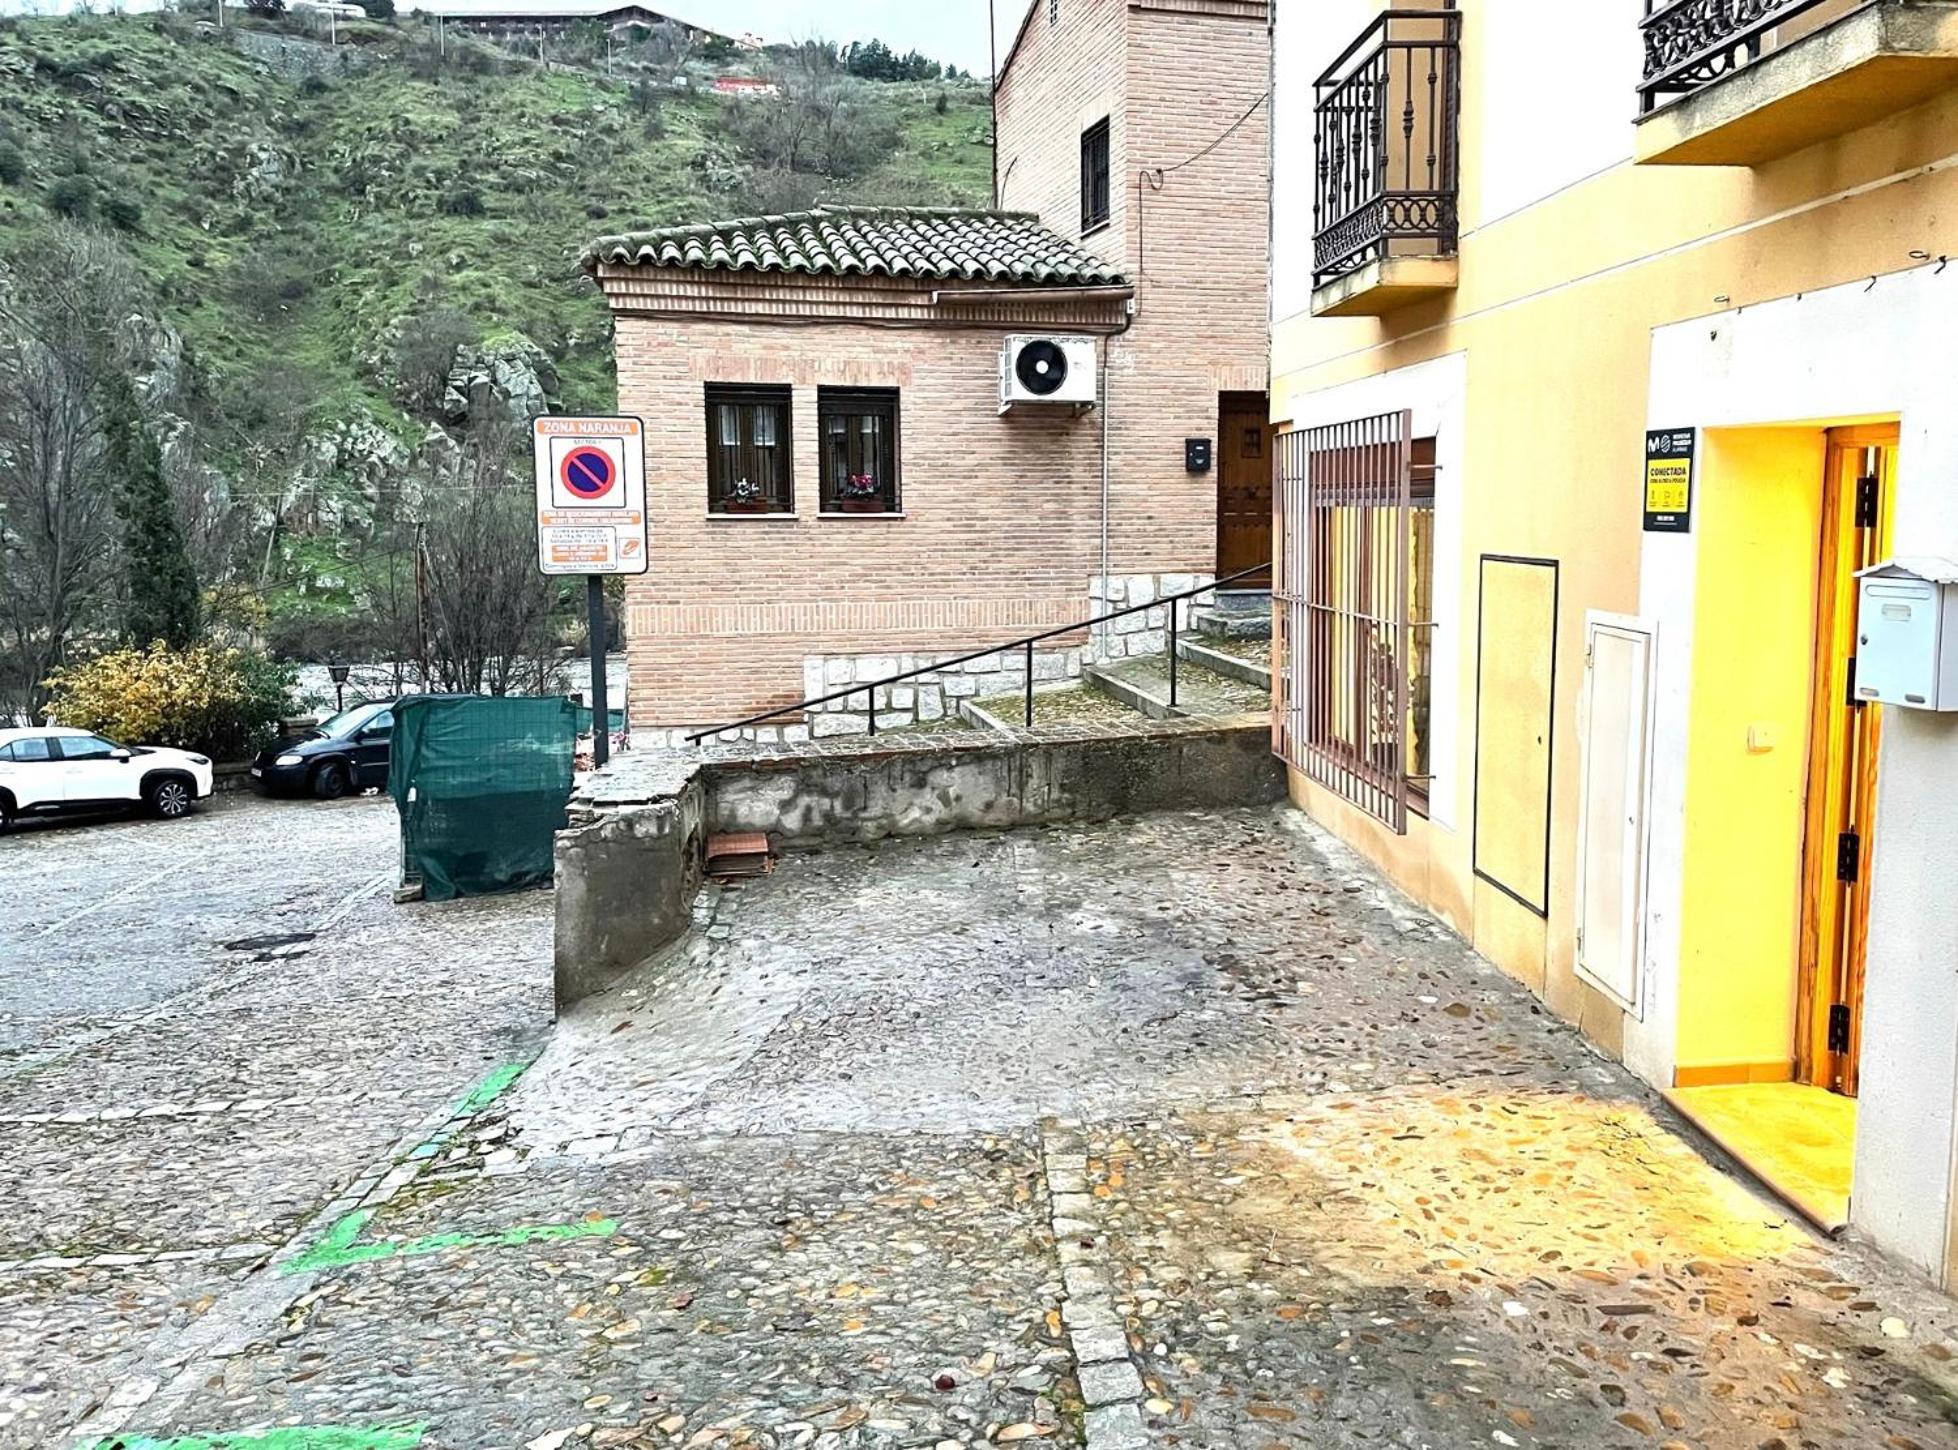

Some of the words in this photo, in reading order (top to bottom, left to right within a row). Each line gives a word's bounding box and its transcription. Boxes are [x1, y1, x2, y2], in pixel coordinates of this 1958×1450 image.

[543, 421, 576, 434] ZONA
[578, 422, 632, 435] NARANJA
[1650, 466, 1687, 477] CONECTADA
